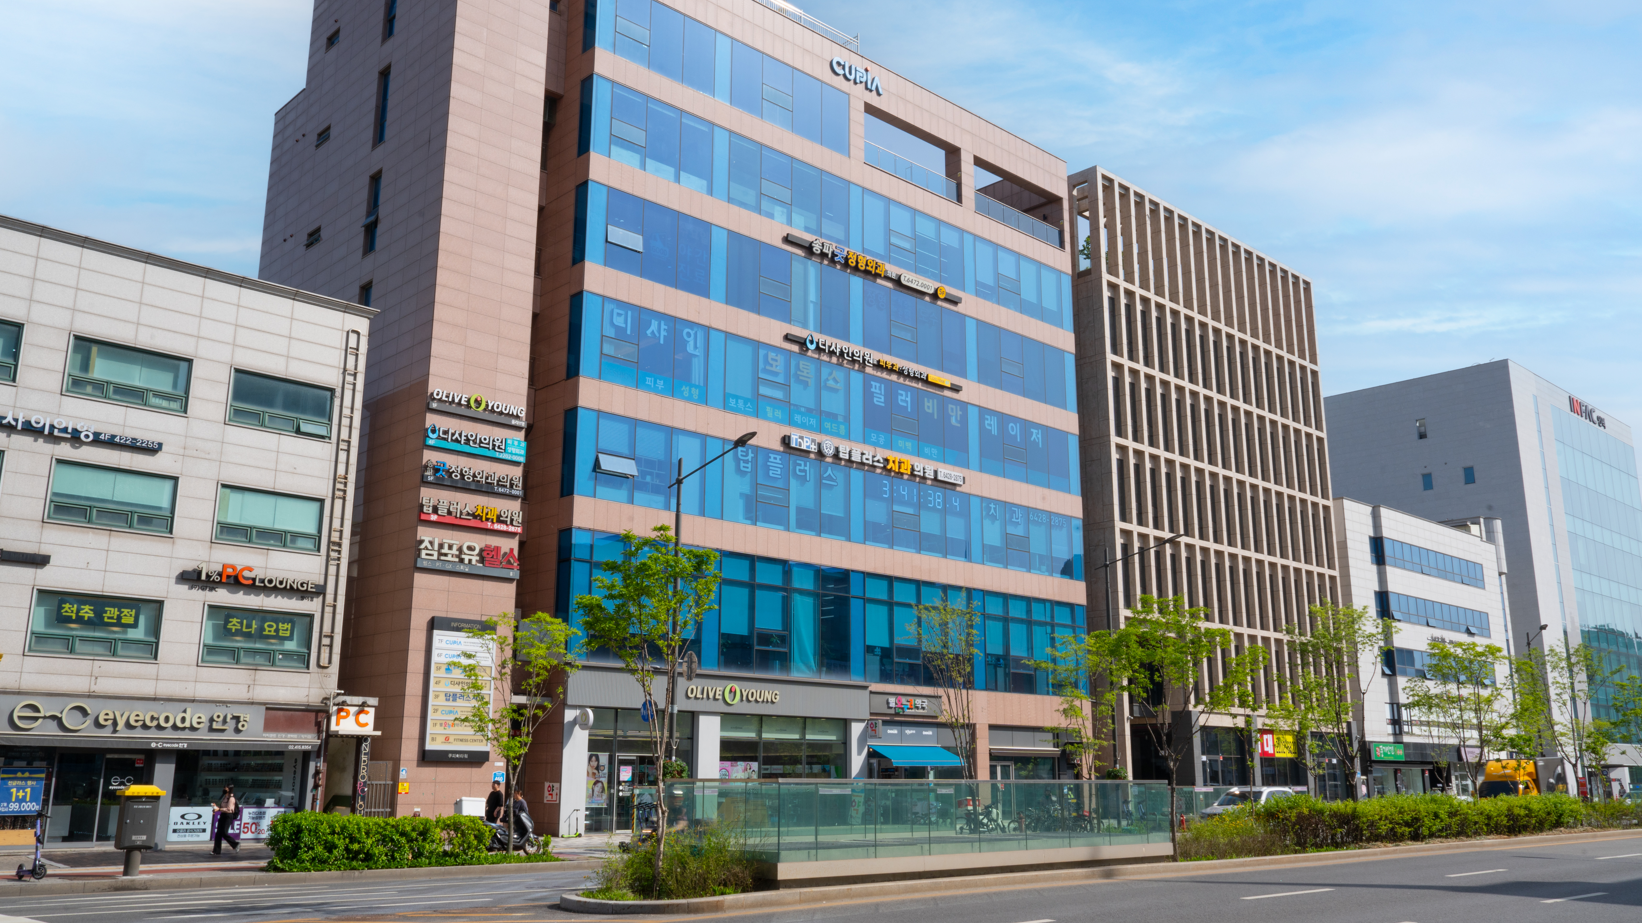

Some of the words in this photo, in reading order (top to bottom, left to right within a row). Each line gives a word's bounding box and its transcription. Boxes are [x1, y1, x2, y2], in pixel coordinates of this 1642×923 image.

[830, 56, 883, 97] CUPIA
[645, 375, 665, 390] 피부
[680, 385, 699, 400] 성형
[433, 388, 469, 405] OLIVE
[487, 399, 526, 417] YOUNG
[728, 397, 754, 412] 보톡스
[765, 406, 782, 420] 필러
[793, 413, 817, 428] 레이저
[823, 421, 846, 436] 여드름
[99, 433, 111, 441] 4F
[114, 436, 159, 449] 422-2255
[439, 427, 506, 453] 디샤인의원
[870, 432, 886, 445] 모공
[255, 574, 317, 592] LOUNGE
[61, 602, 95, 621] 척추
[103, 604, 136, 624] 관절
[226, 617, 258, 634] 추나
[263, 621, 292, 637] 요법
[687, 685, 722, 699] OLIVE
[741, 688, 780, 703] YOUNG
[98, 707, 206, 731] eyecode
[212, 711, 250, 731] 안경
[336, 707, 370, 728] PC
[869, 721, 878, 735] 약
[10, 787, 31, 802] 1+1
[547, 783, 555, 799] 약
